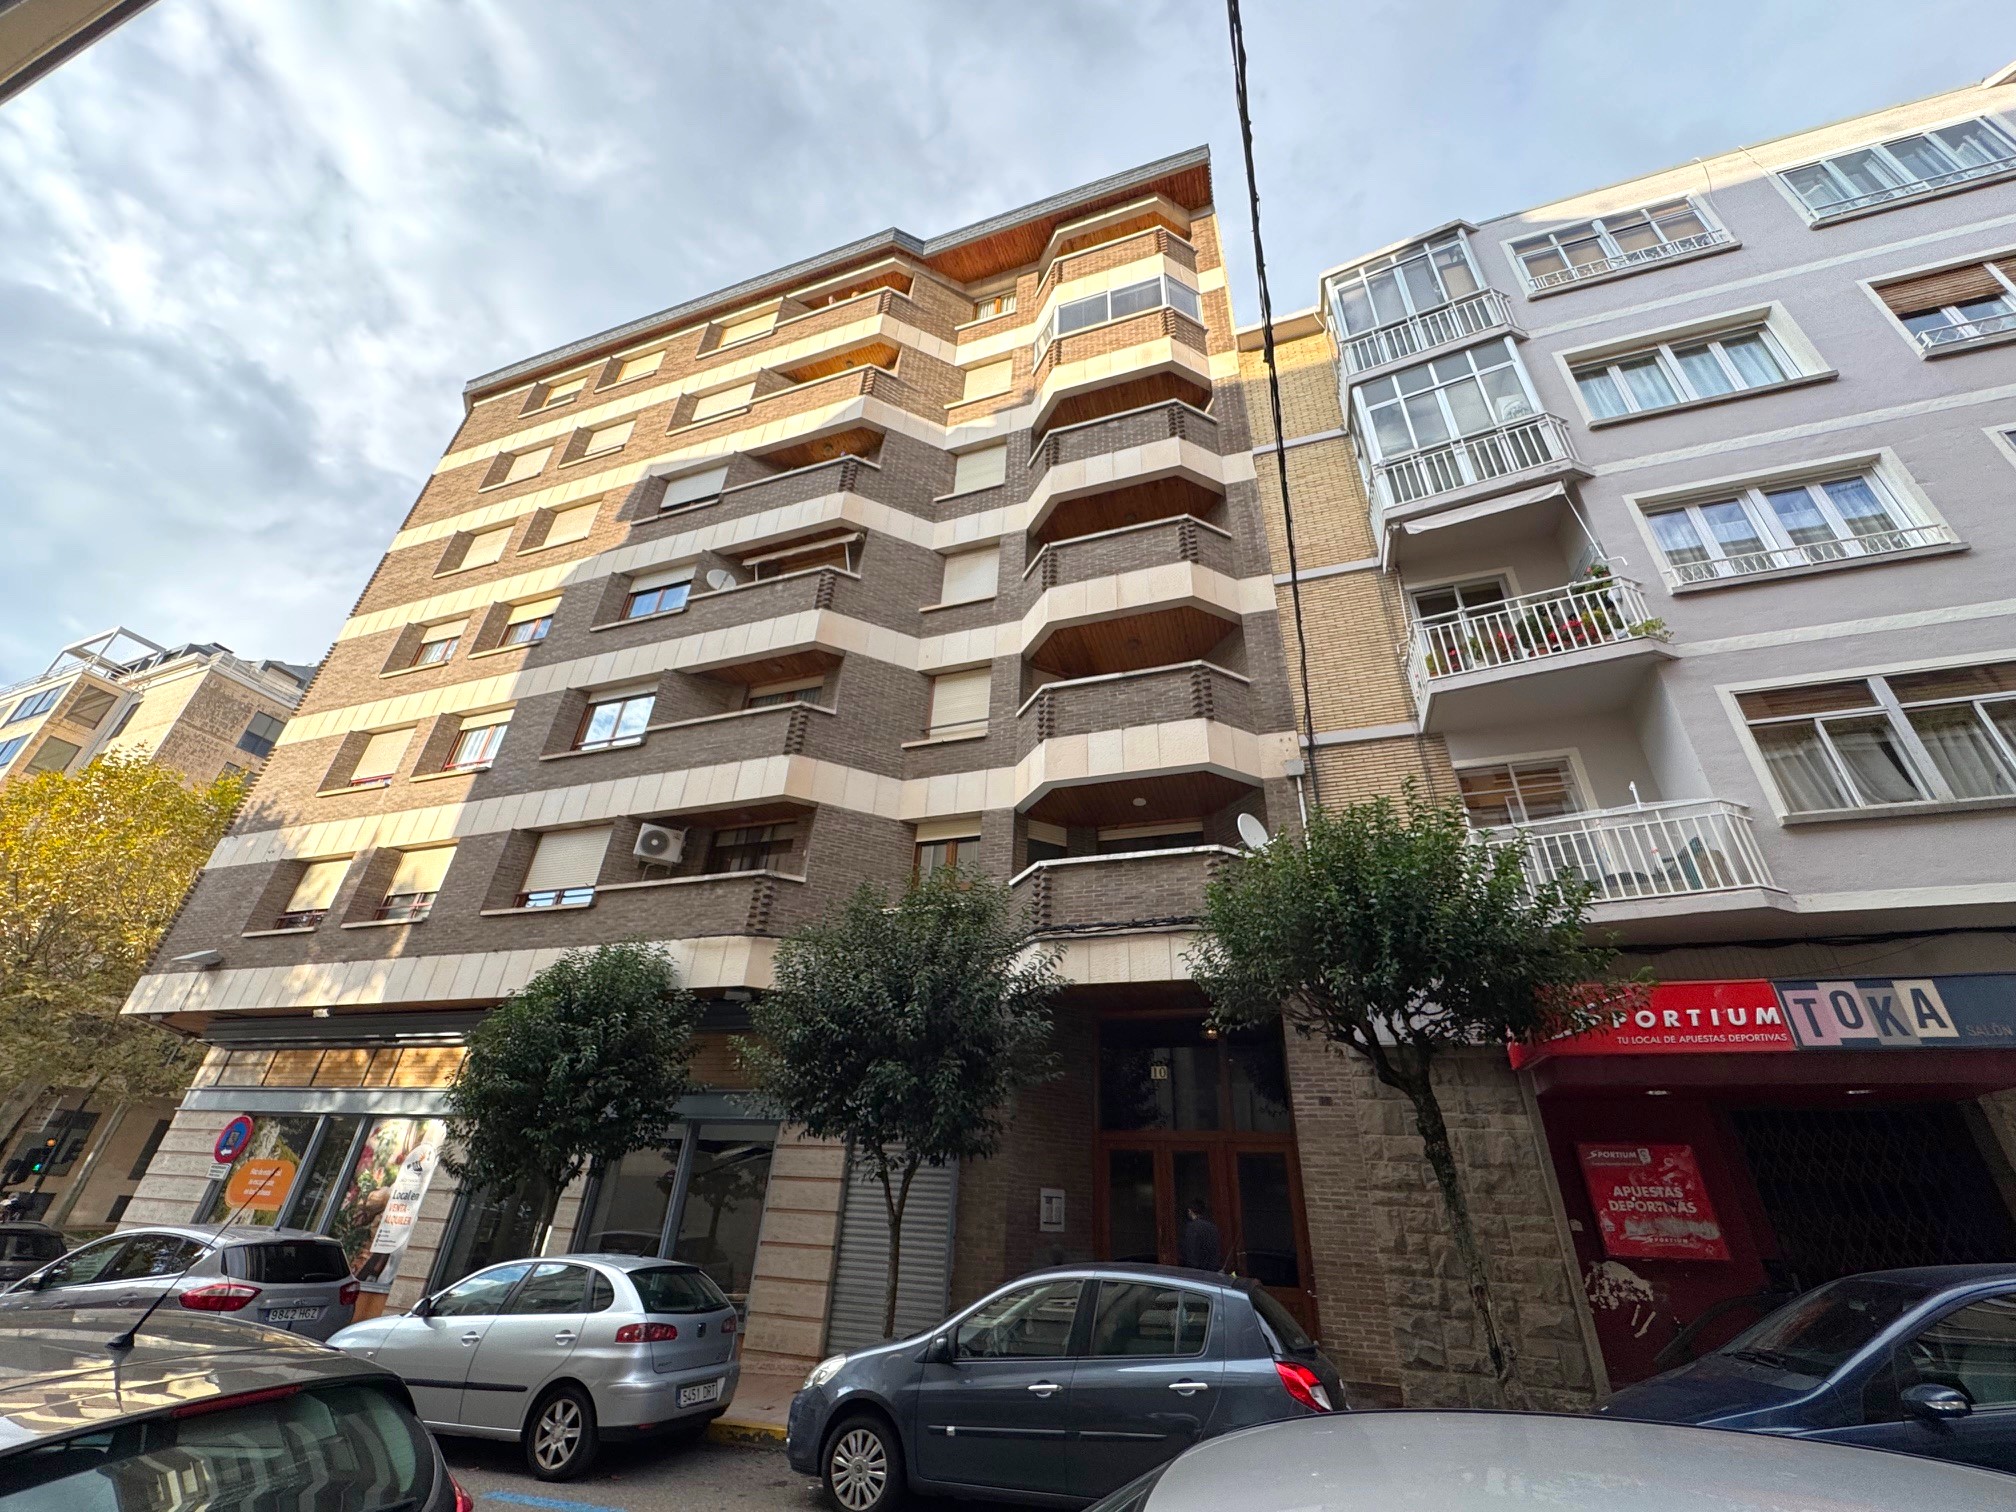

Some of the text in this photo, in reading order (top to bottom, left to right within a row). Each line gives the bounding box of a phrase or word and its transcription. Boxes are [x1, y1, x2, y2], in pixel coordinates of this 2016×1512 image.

[1793, 988, 1949, 1037] TOKA
[1617, 1033, 1788, 1045] TU LOCAL DE APUESTAS DEPORTIVAS
[1153, 1067, 1166, 1078] 10
[1586, 1150, 1637, 1160] SPORTIUM
[392, 1190, 411, 1200] Local
[1613, 1185, 1684, 1198] APUESTAS
[1608, 1200, 1697, 1213] DEPORTIVAS
[271, 1308, 317, 1320] 9842 HGZ
[683, 1384, 716, 1402] 5451 DRT
